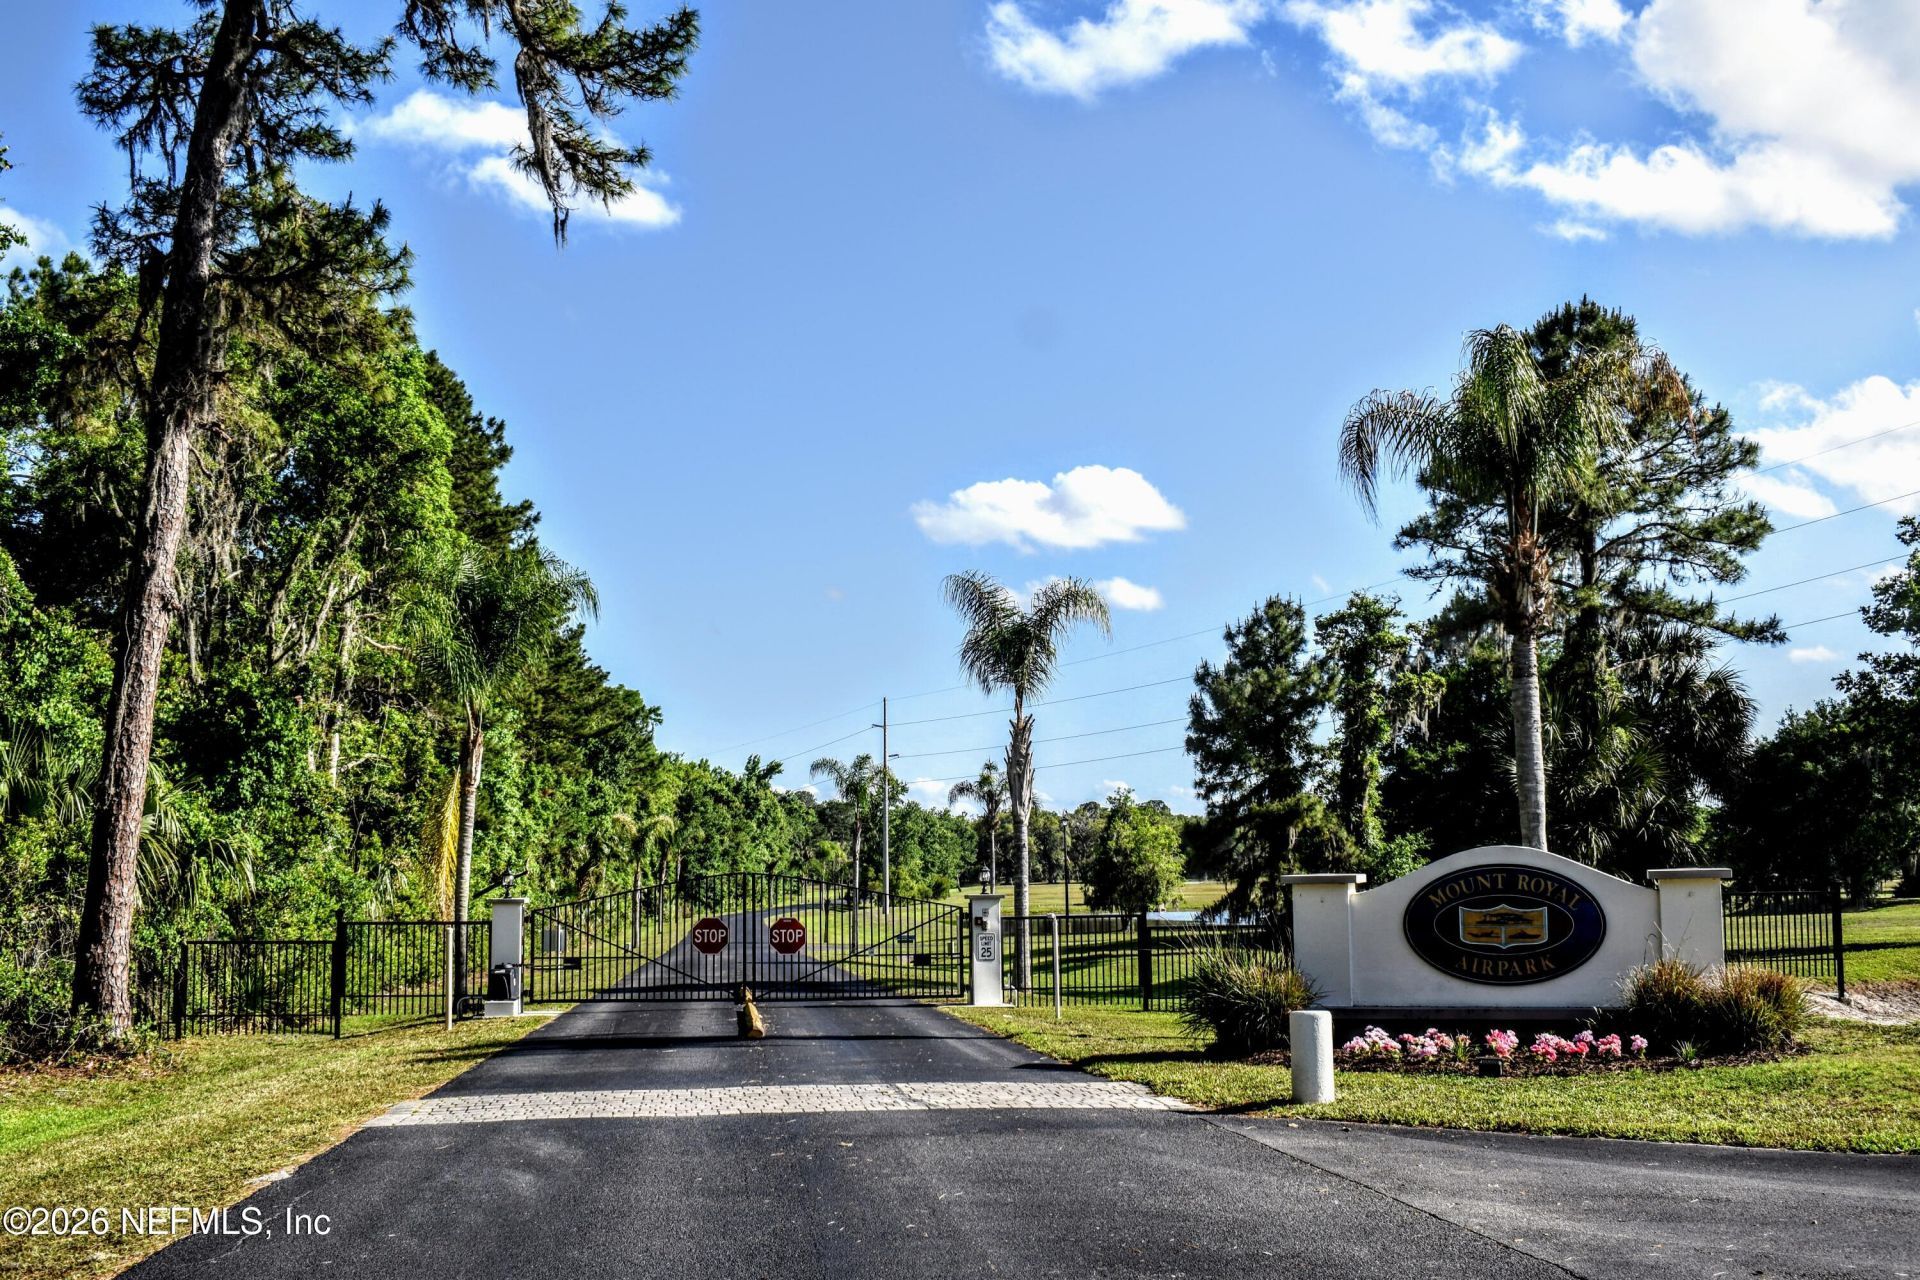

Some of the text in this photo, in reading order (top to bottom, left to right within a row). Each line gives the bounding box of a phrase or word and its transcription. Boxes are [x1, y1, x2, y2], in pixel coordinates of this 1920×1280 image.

[1428, 873, 1584, 911] MOUNT ROYAL
[694, 929, 727, 943] STOP
[772, 929, 804, 943] STOP
[981, 948, 992, 957] 25
[1455, 954, 1557, 977] AIRPARK
